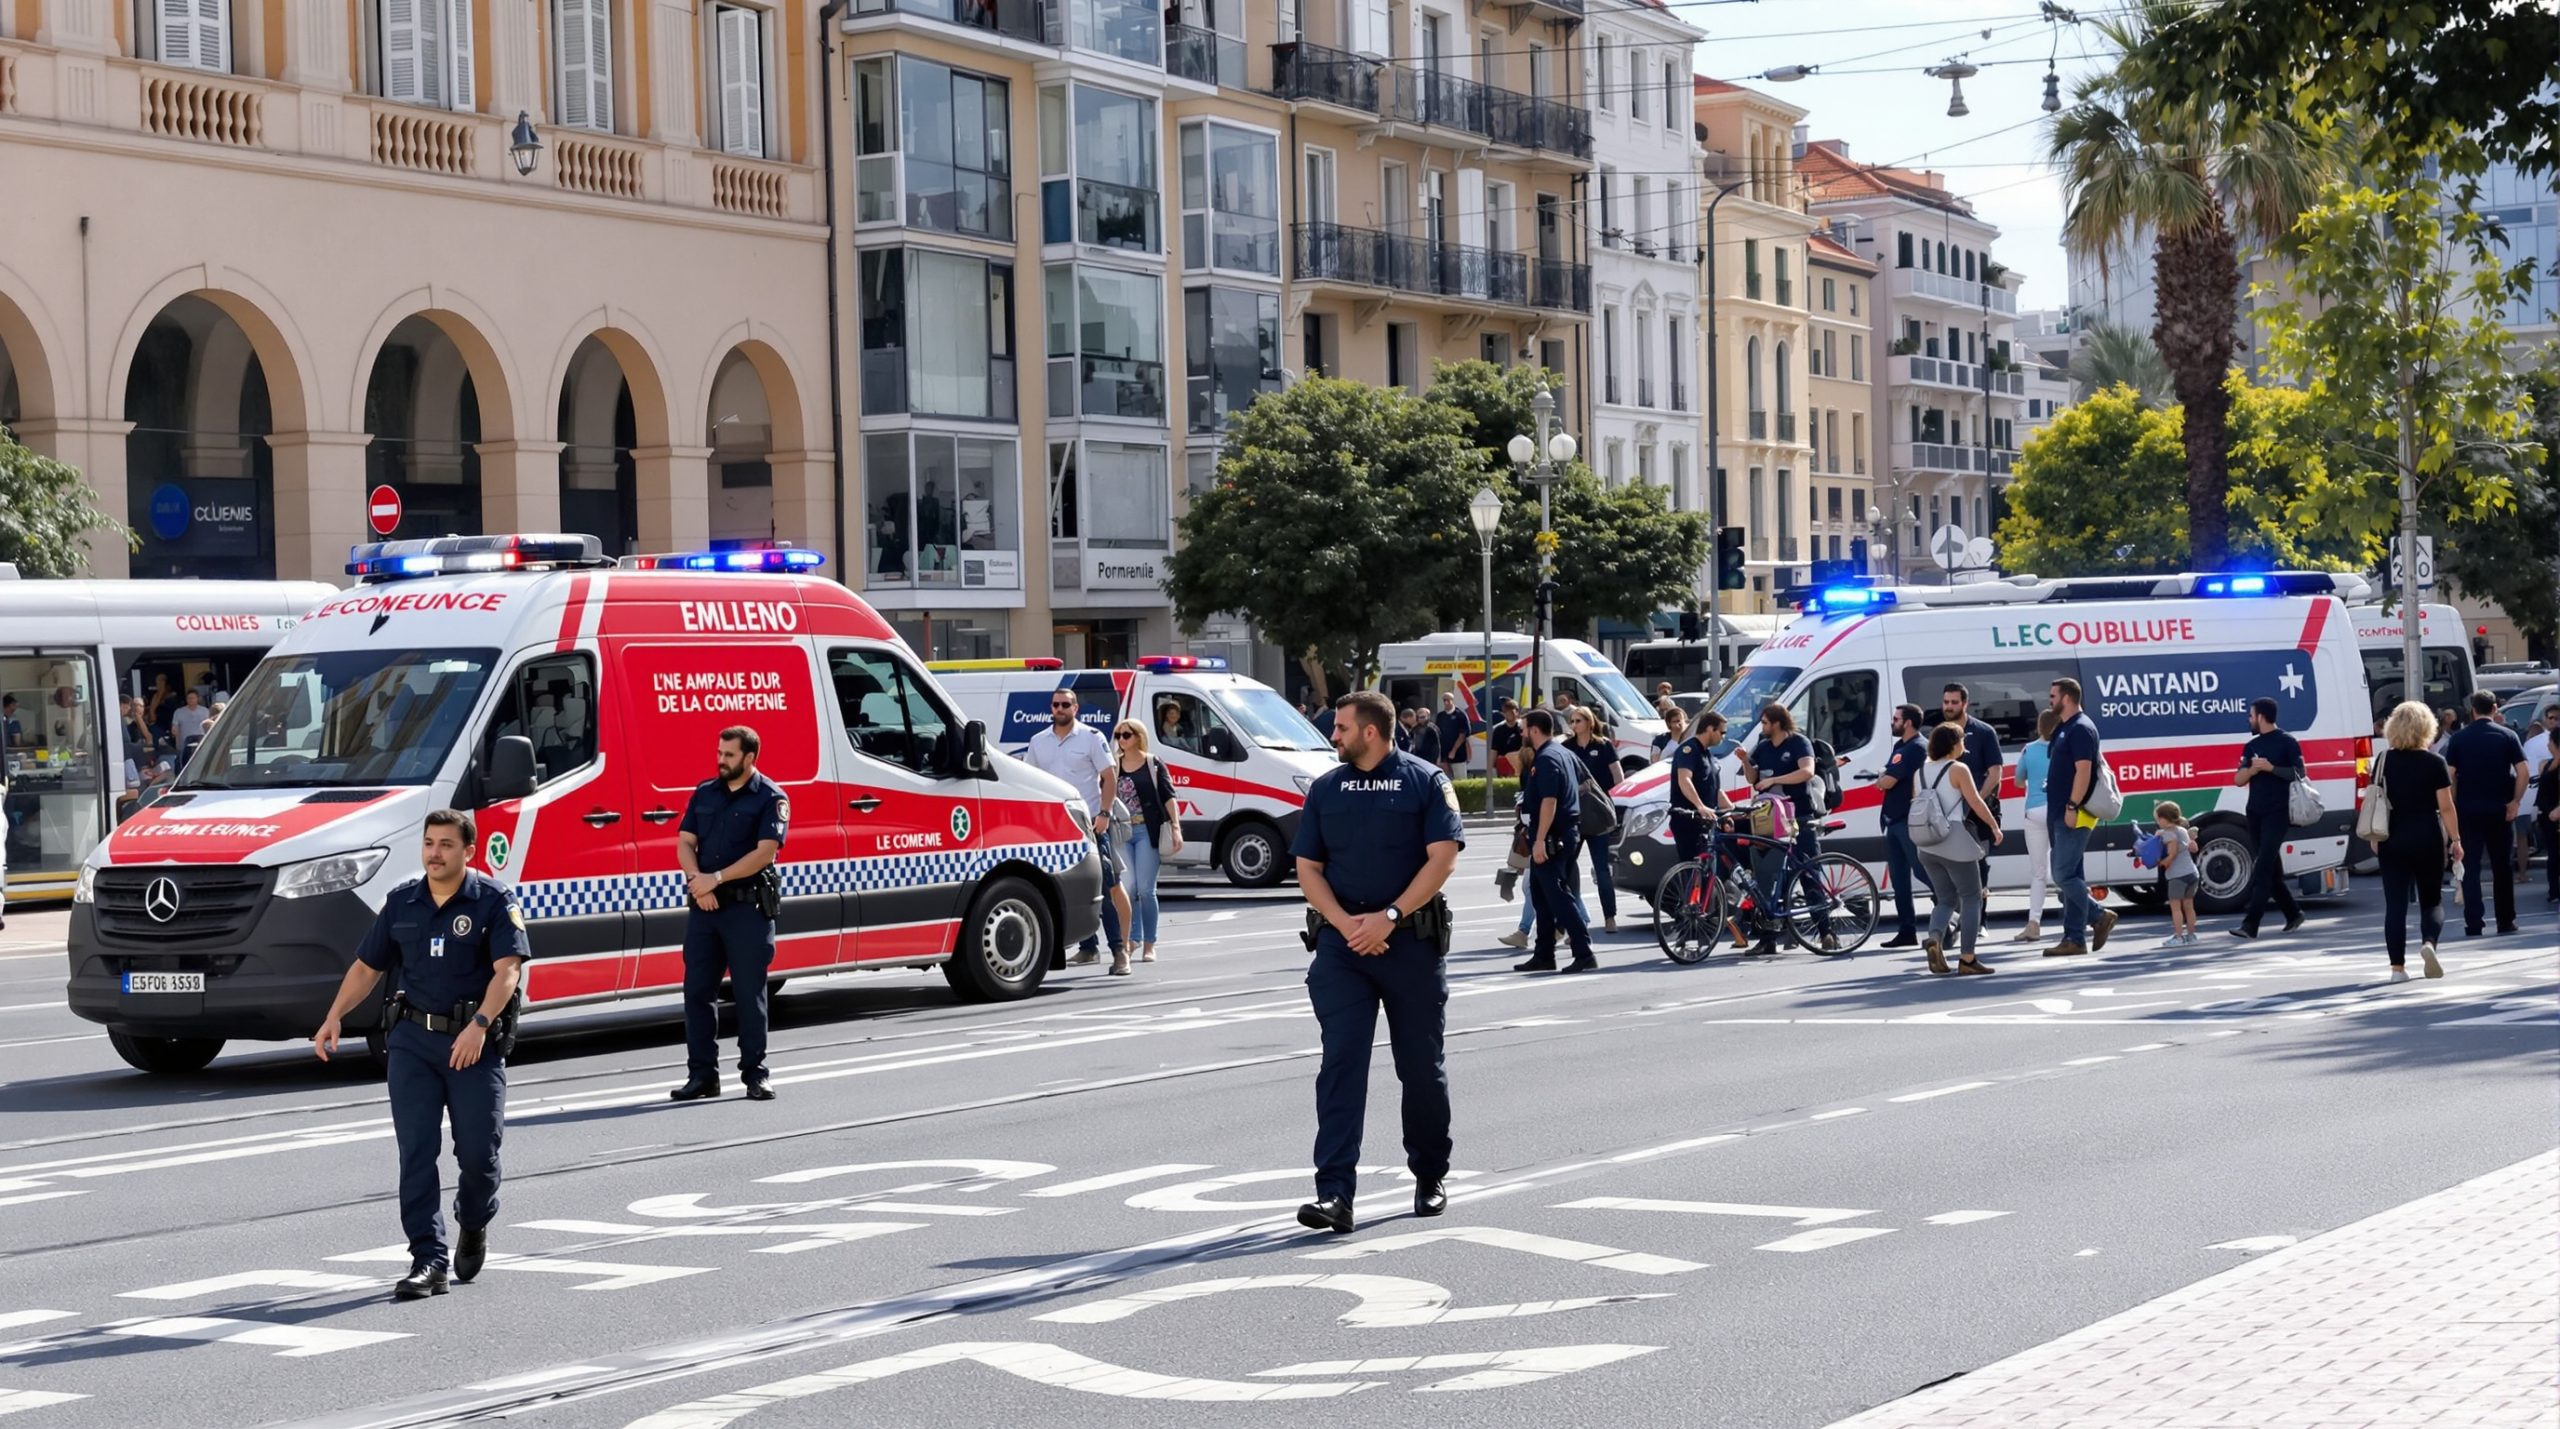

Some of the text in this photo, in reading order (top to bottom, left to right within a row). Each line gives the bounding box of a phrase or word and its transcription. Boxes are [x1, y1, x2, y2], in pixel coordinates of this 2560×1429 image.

[176, 615, 259, 631] COLLNIES
[680, 601, 798, 631] EMLLENO
[2057, 618, 2195, 645] OUBLLUFE
[685, 672, 747, 690] AMPAUE
[750, 672, 781, 690] DUR
[2096, 671, 2219, 697] VANTAND
[658, 695, 679, 712] DE
[681, 694, 702, 712] LA
[2179, 701, 2199, 714] NE
[2119, 765, 2141, 781] ED
[876, 835, 891, 851] LE
